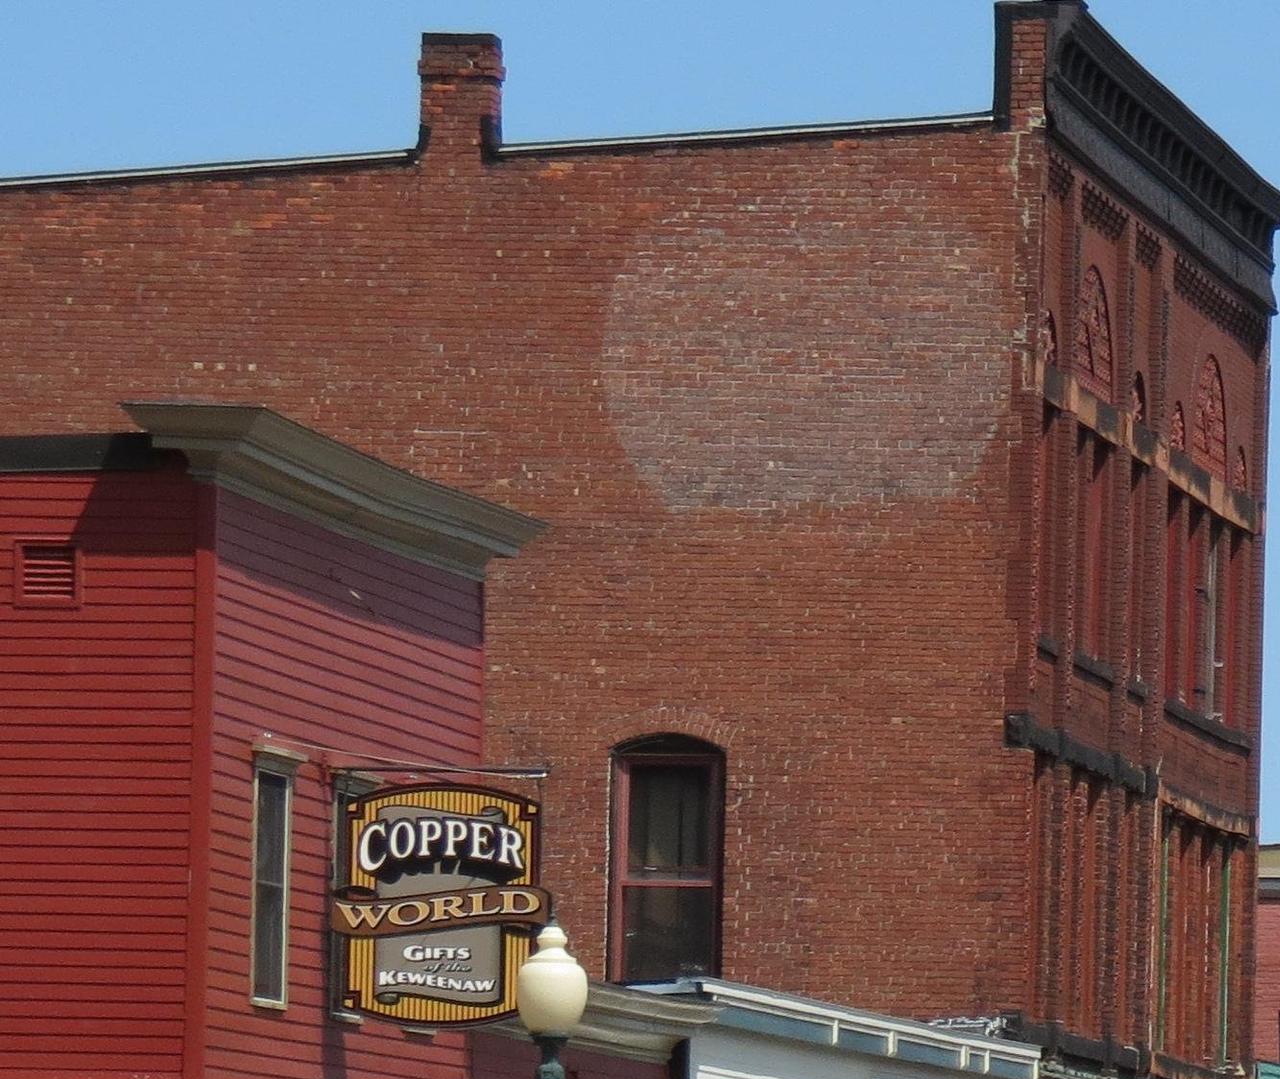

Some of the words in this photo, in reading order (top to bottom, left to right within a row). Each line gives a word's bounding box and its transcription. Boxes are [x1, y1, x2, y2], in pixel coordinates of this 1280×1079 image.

[357, 817, 525, 873] COPPER
[334, 889, 541, 930] WORLD
[378, 969, 496, 993] KEWEENAW
[423, 961, 442, 975] of
[443, 961, 472, 973] the
